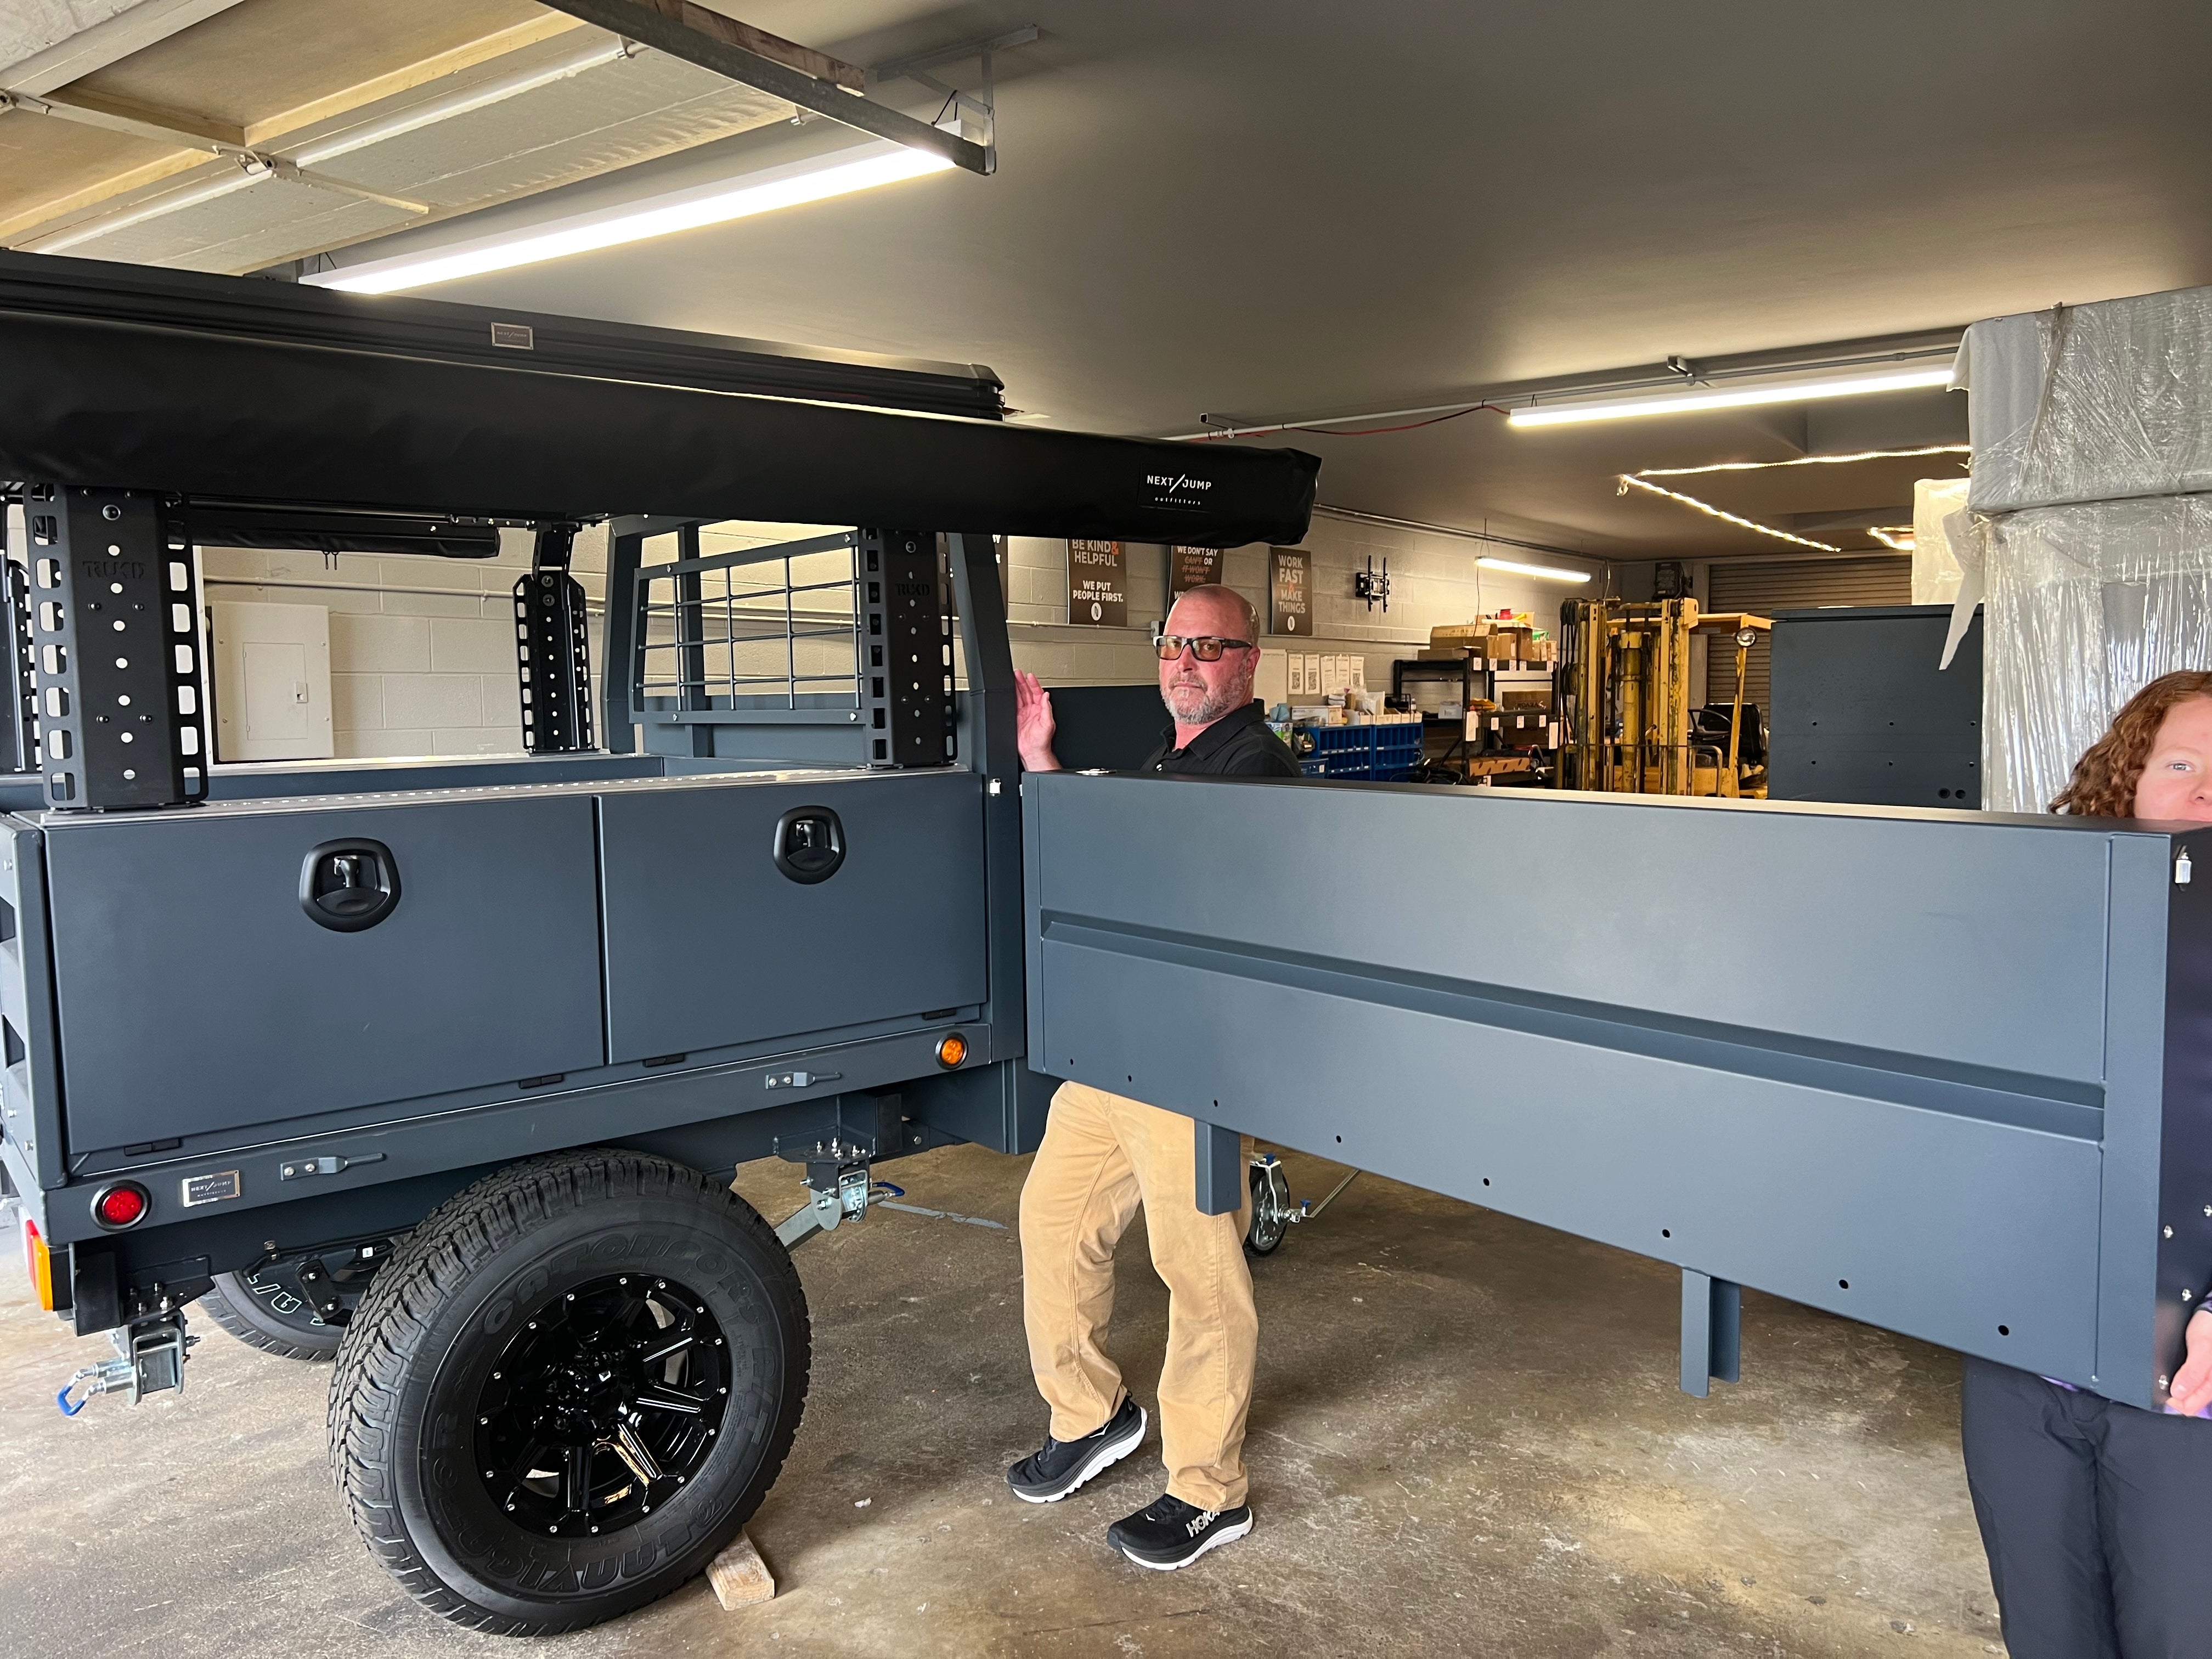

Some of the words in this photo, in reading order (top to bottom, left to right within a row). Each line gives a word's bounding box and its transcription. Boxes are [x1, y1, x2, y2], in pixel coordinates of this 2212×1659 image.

[1073, 539, 1085, 550] BE
[1087, 540, 1111, 553] KIND
[1177, 545, 1187, 554] WE
[1206, 549, 1218, 557] SAY
[1075, 550, 1117, 567] HELPFUL
[1204, 557, 1213, 566] OR
[1278, 555, 1303, 568] WORK
[1279, 568, 1304, 584] FAST
[1083, 580, 1095, 590] WE
[1097, 582, 1111, 591] PUT
[1073, 590, 1100, 601] PEOPLE
[1102, 592, 1124, 602] FIRST.
[1174, 591, 1184, 600] W
[1281, 589, 1302, 602] MAKE
[1278, 601, 1306, 613] THINGS
